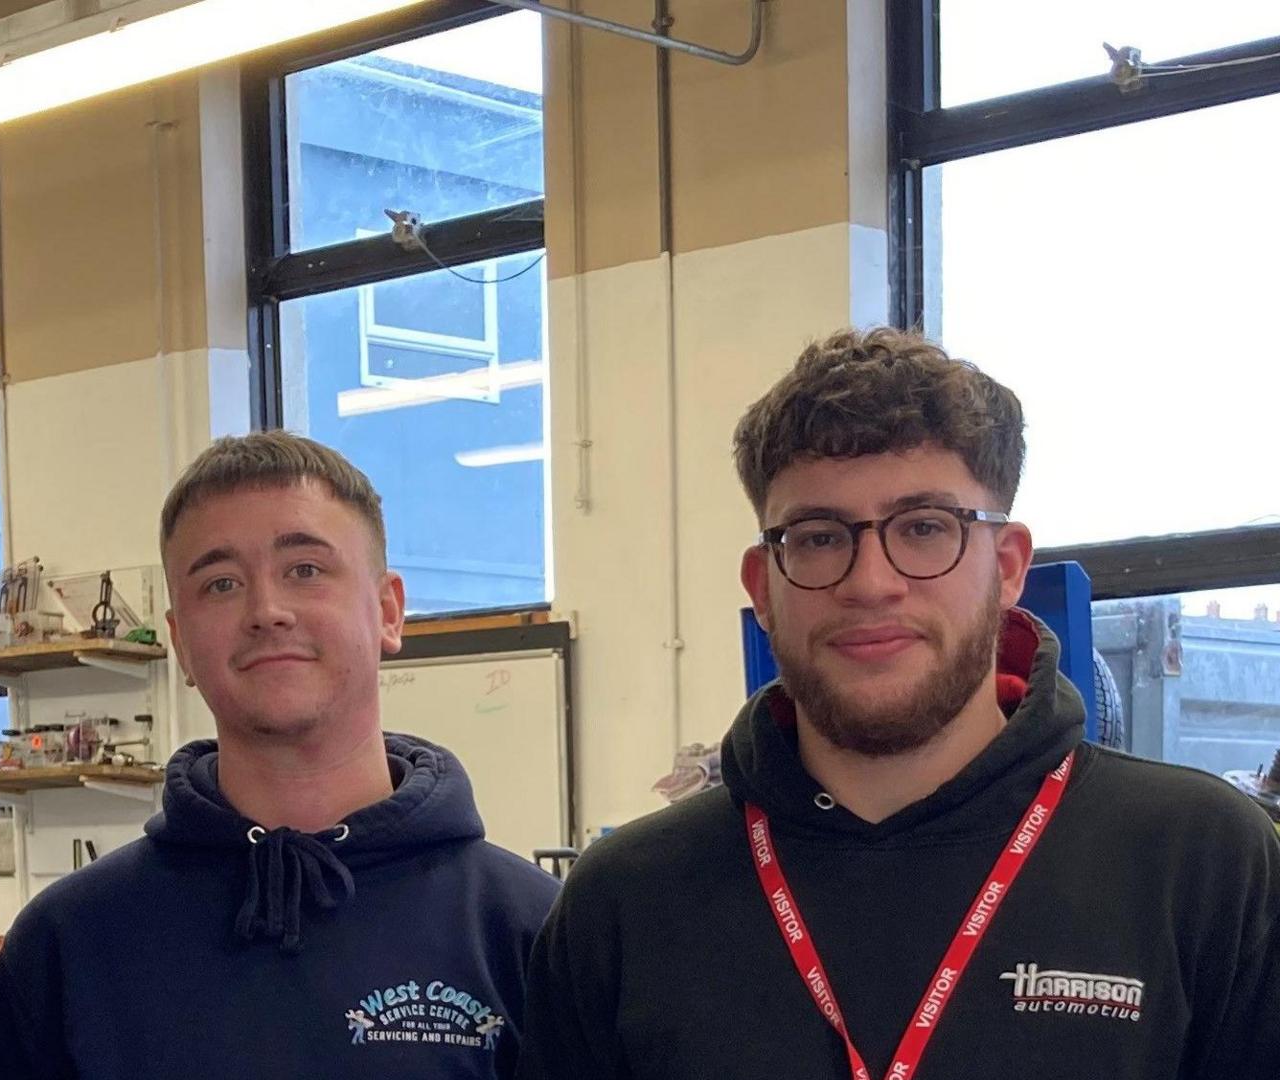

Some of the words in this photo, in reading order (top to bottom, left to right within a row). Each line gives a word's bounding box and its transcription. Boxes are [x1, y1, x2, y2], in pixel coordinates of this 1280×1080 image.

[751, 819, 772, 868] VISITOR
[1010, 803, 1048, 856] VISITOR
[771, 886, 804, 945] VISITOR
[962, 880, 1005, 937] VISITOR
[360, 980, 421, 1017] West
[426, 981, 492, 1024] Coast
[379, 1004, 426, 1026] SERVICE
[429, 1005, 471, 1030] CENTRE
[805, 965, 840, 1027] VISITOR
[915, 966, 958, 1029] VISITOR
[1014, 1000, 1141, 1022] automotive
[367, 1031, 419, 1042] SERVICING
[421, 1032, 442, 1043] AND
[445, 1034, 482, 1047] REPAIRS
[402, 1021, 416, 1029] FOR
[417, 1021, 431, 1030] ALL
